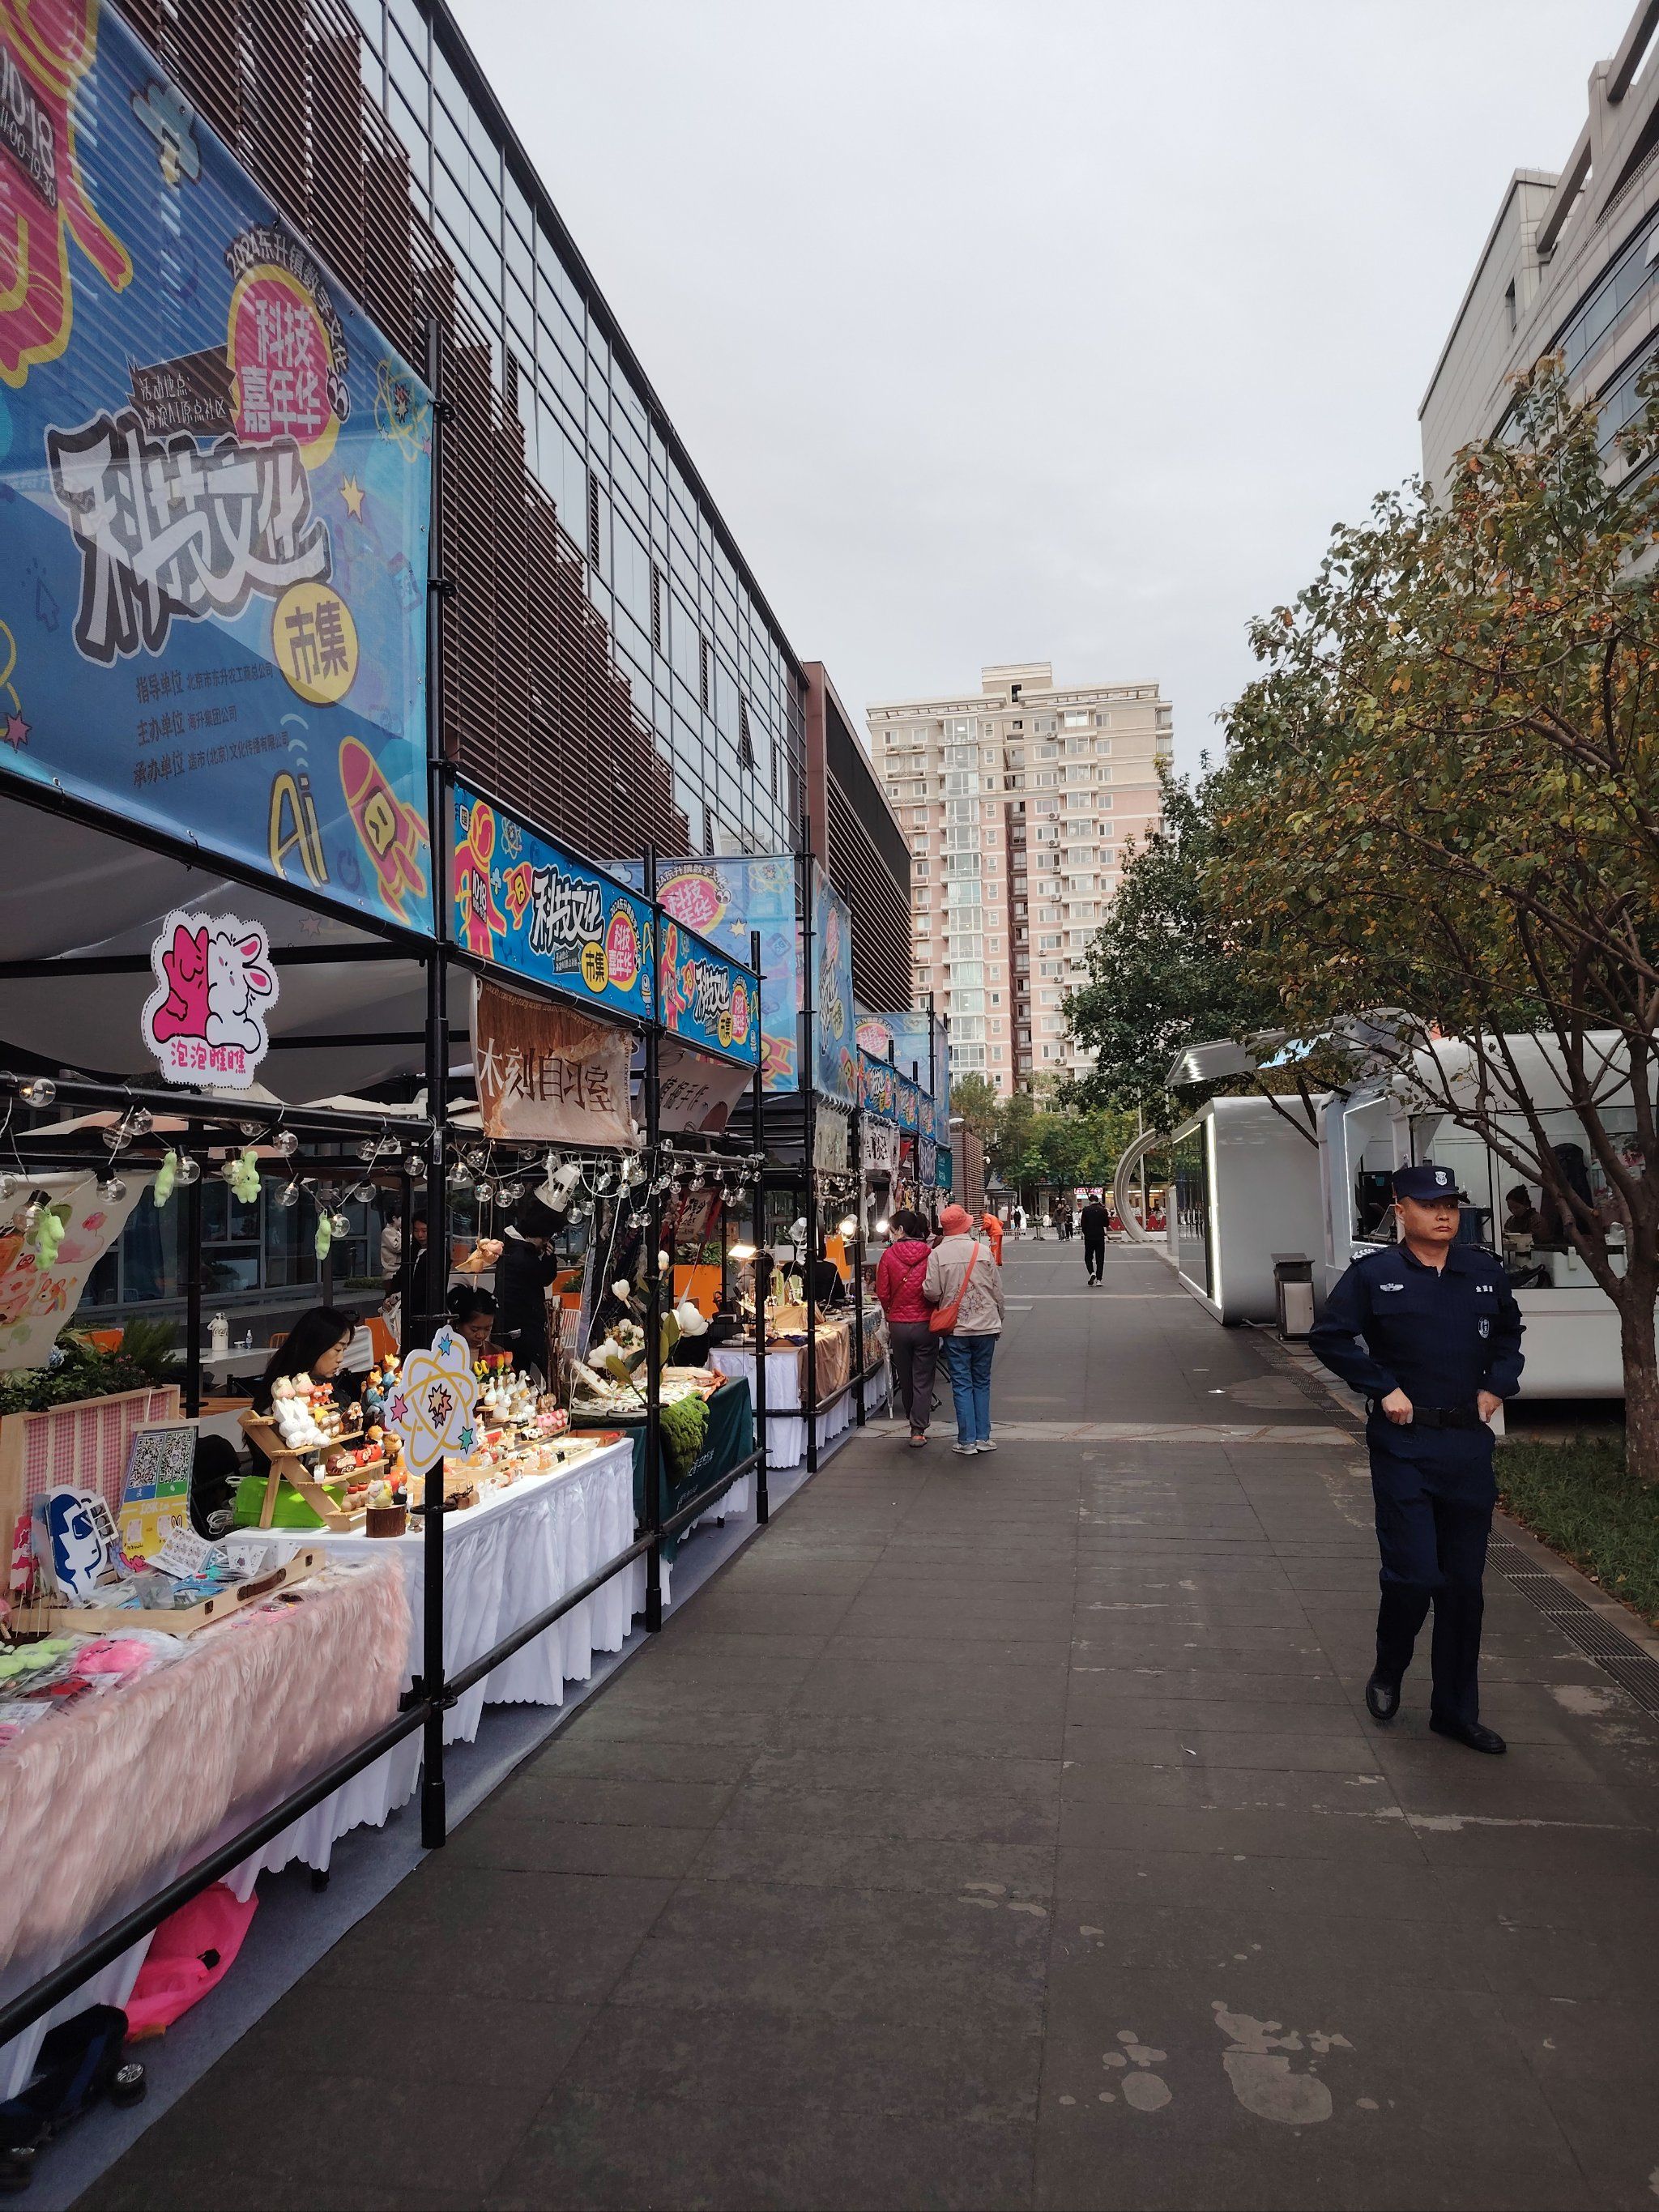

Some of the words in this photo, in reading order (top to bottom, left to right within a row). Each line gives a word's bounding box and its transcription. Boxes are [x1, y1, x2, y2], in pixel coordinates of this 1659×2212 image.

[255, 299, 314, 369] 科技
[241, 364, 322, 435] 嘉年华
[50, 411, 331, 658] 科技文化
[284, 599, 351, 685] 市集
[136, 669, 185, 704] 指导单位
[137, 710, 186, 747] 主办单位
[134, 750, 186, 790] 承办单位
[531, 867, 604, 952] 科技文化
[667, 879, 704, 914] 科技
[674, 897, 713, 926] 年华
[614, 924, 631, 951] 科技
[585, 951, 605, 982] 市集
[608, 950, 633, 977] 嘉年华
[478, 1038, 616, 1113] 木刻自习室
